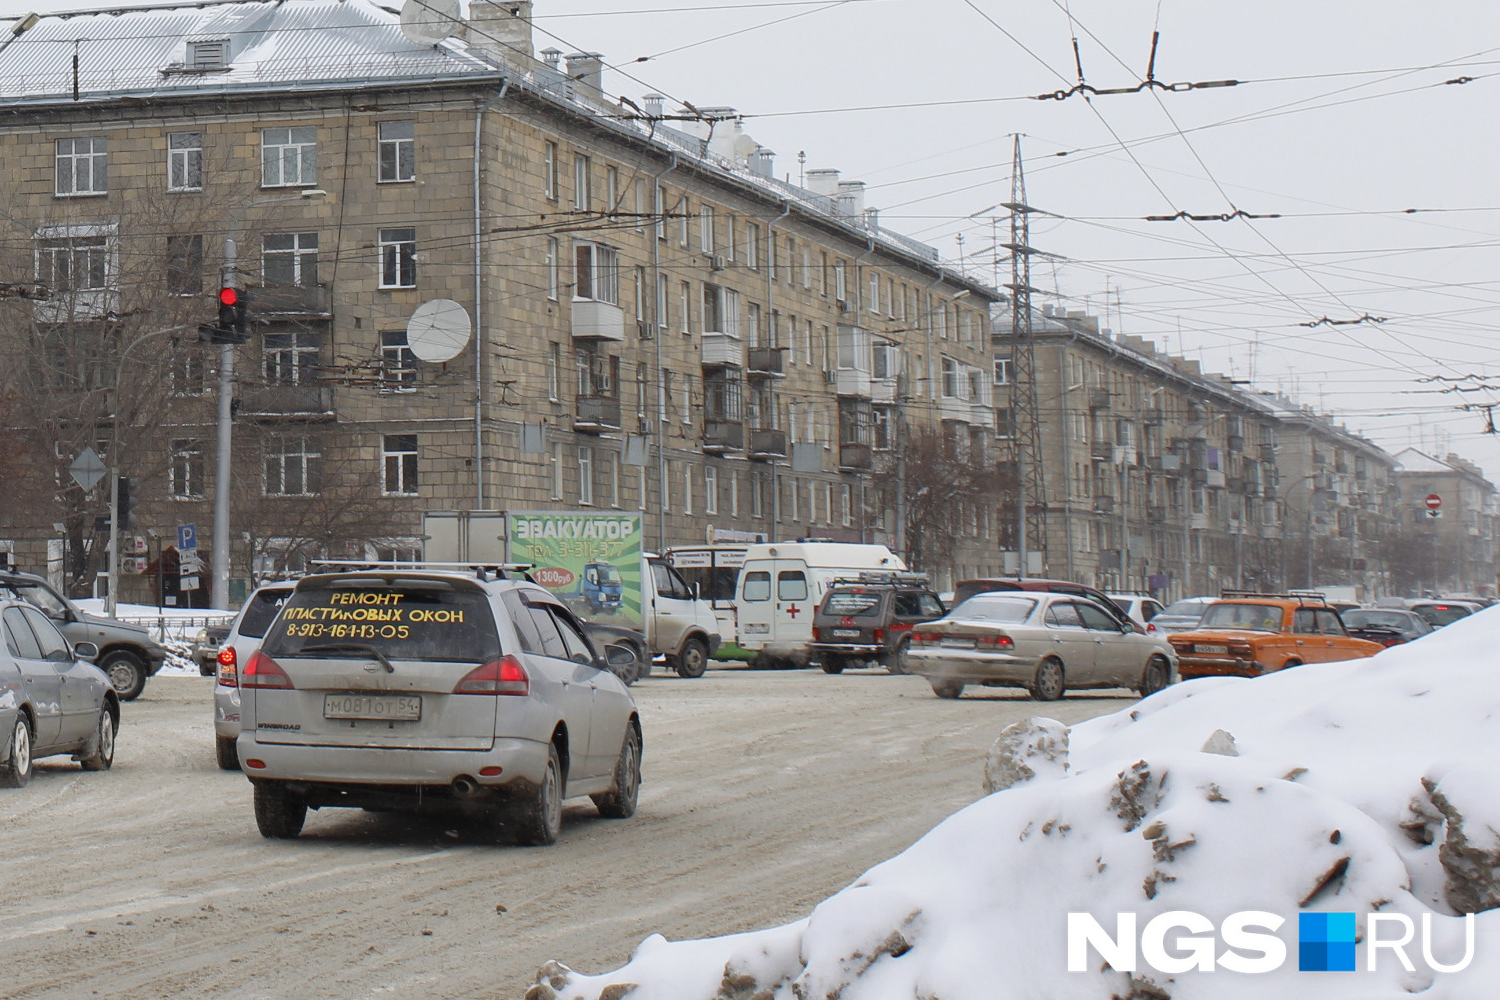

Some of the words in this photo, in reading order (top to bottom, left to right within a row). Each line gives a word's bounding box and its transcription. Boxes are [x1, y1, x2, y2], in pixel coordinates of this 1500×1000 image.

[517, 519, 634, 539] ЭВАКУАТОР
[559, 541, 624, 558] 3-311-377
[330, 593, 404, 606] РЕМОНТ
[408, 609, 464, 623] ОКОН
[286, 623, 410, 639] 8-913-464-13-05
